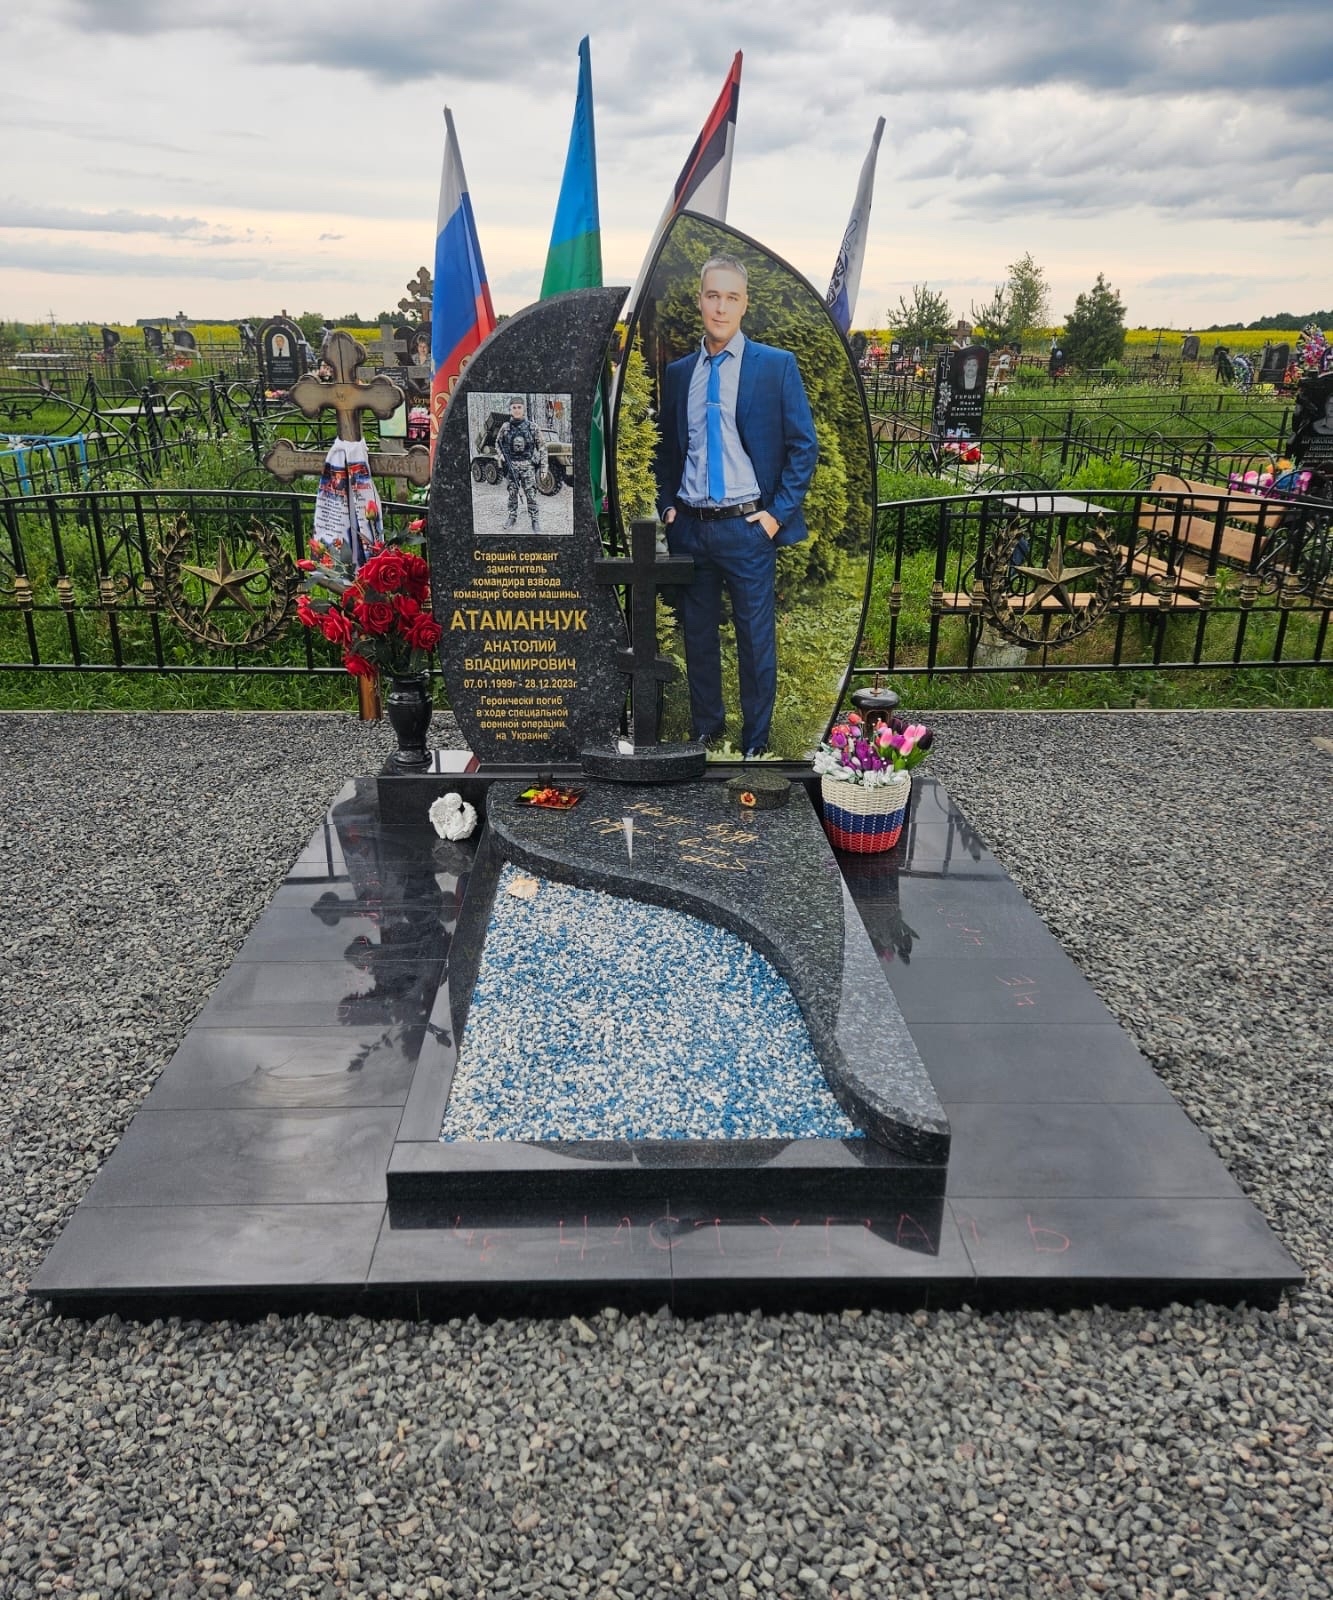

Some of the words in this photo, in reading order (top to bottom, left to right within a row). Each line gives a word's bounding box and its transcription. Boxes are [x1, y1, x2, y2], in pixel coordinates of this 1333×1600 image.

[473, 550, 517, 562] Старший
[519, 552, 558, 563] сержант
[486, 565, 547, 574] заместитель
[472, 578, 525, 588] командира
[527, 578, 561, 587] взвода
[453, 590, 500, 601] командир
[502, 588, 537, 598] боевой
[450, 609, 588, 631] АТАМАНЧУК
[483, 637, 557, 652] АНАТОЛИЙ
[464, 658, 577, 672] ВЛАДИМИРОВИЧ
[480, 696, 534, 707] Героически
[536, 696, 563, 705] погиб
[476, 709, 482, 717] в
[484, 709, 506, 718] ходе
[508, 708, 569, 717] специальной
[480, 720, 519, 728] военной
